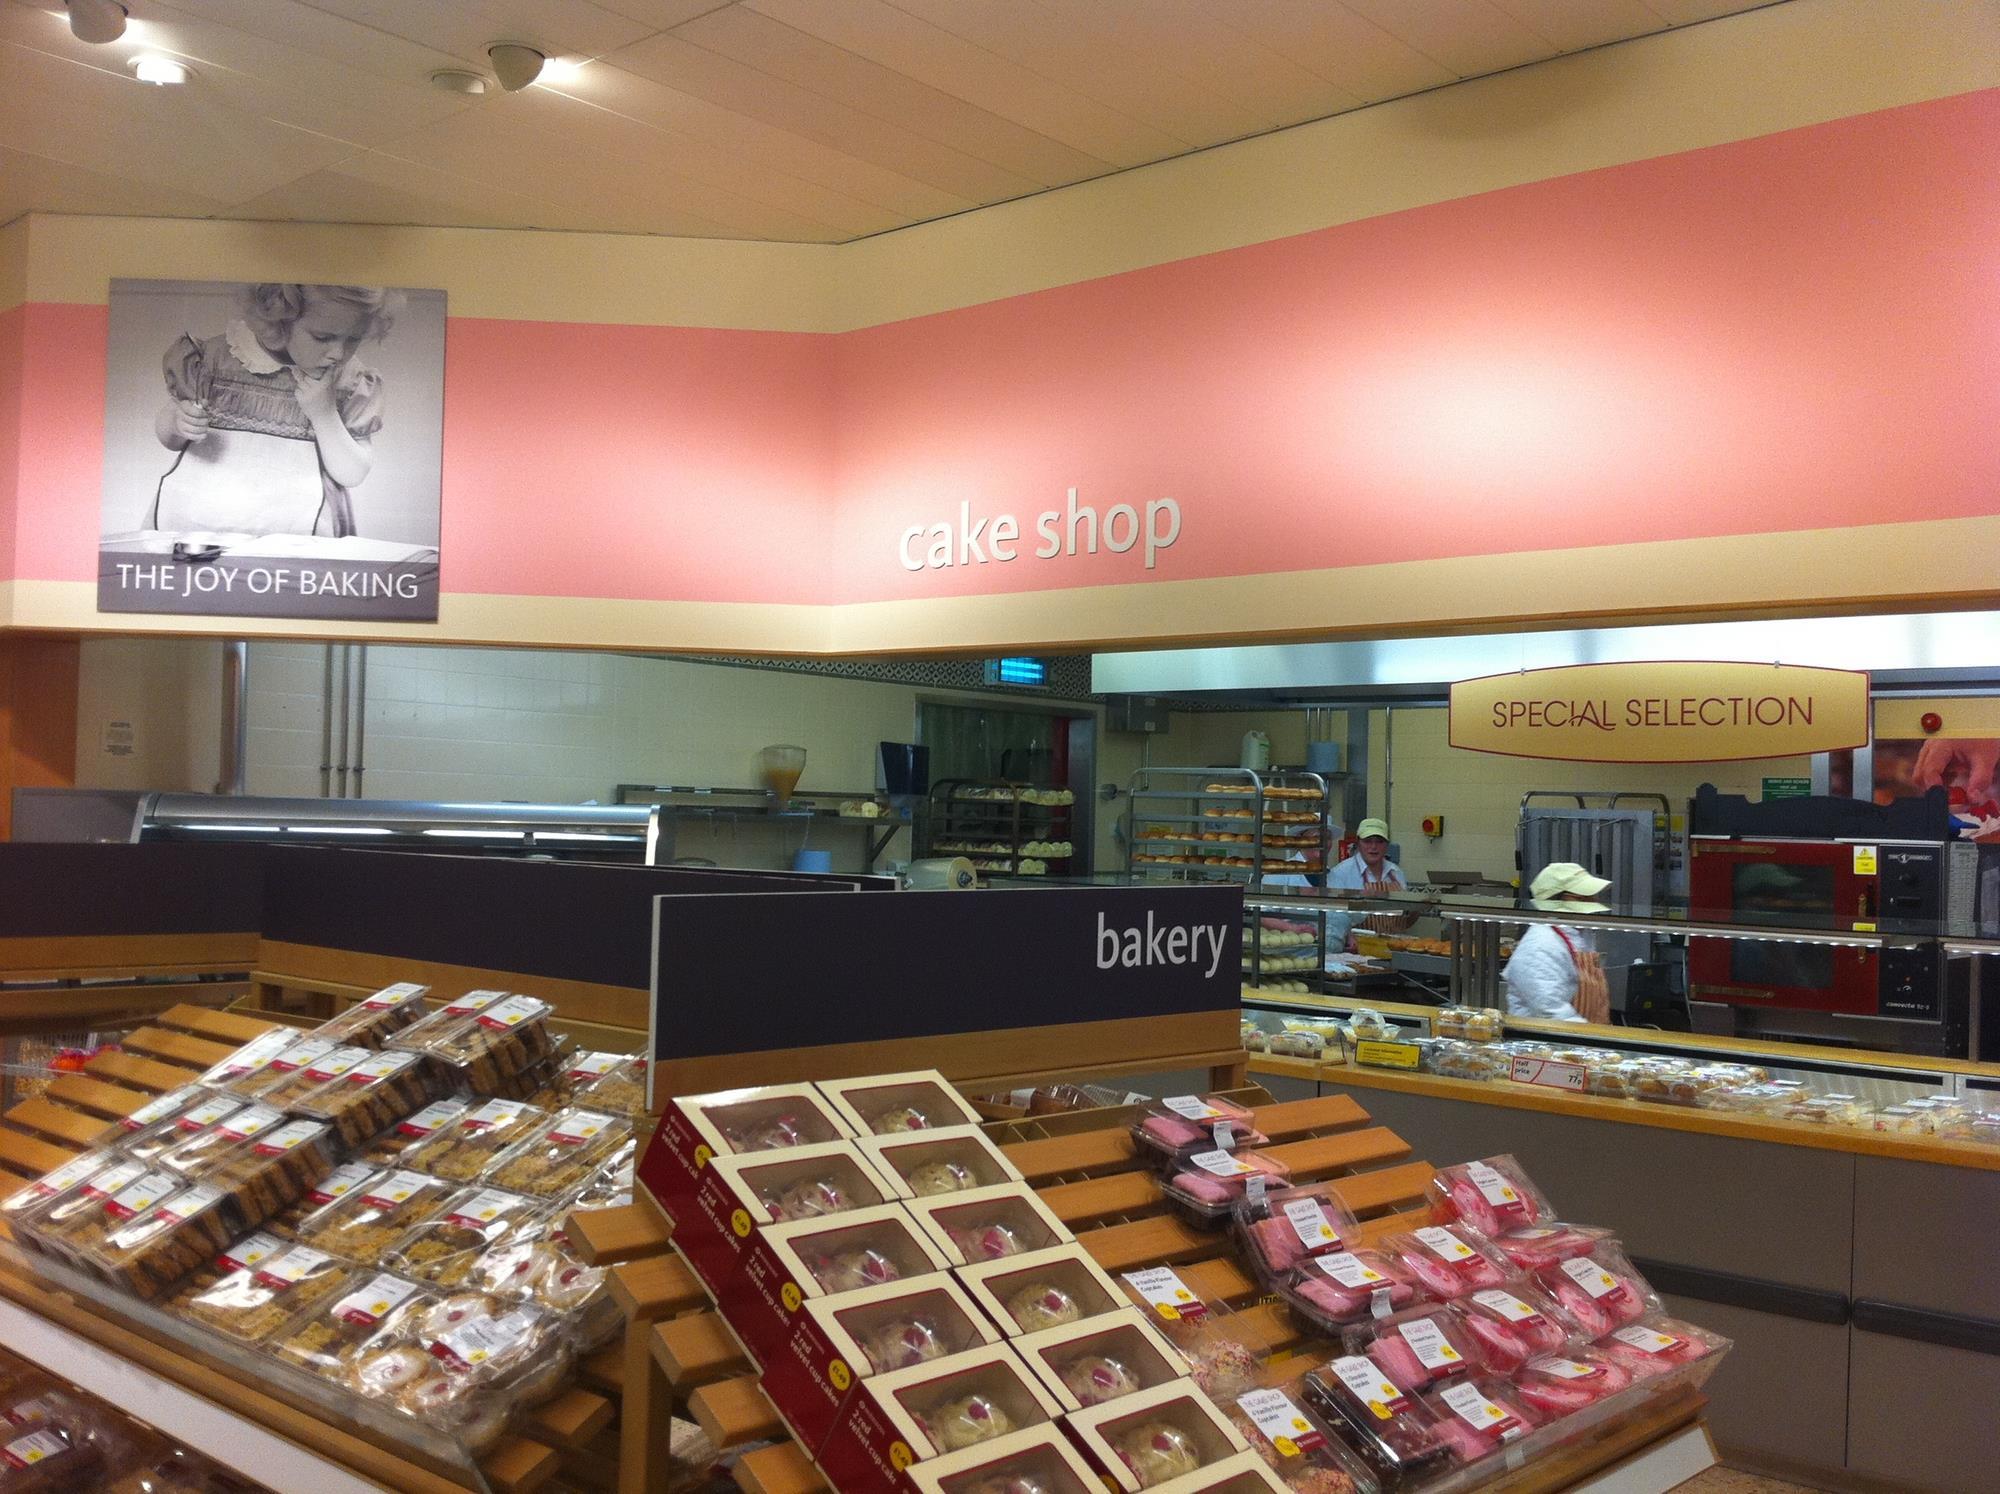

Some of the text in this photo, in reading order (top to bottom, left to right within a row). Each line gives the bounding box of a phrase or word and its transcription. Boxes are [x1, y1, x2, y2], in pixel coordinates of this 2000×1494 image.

[900, 487, 1181, 571] cake shop
[116, 564, 418, 599] THE JOY OF BAKING
[1493, 697, 1813, 731] SPECIAL SELECTION
[1096, 909, 1228, 978] bakery
[1568, 1074, 1582, 1085] 77p
